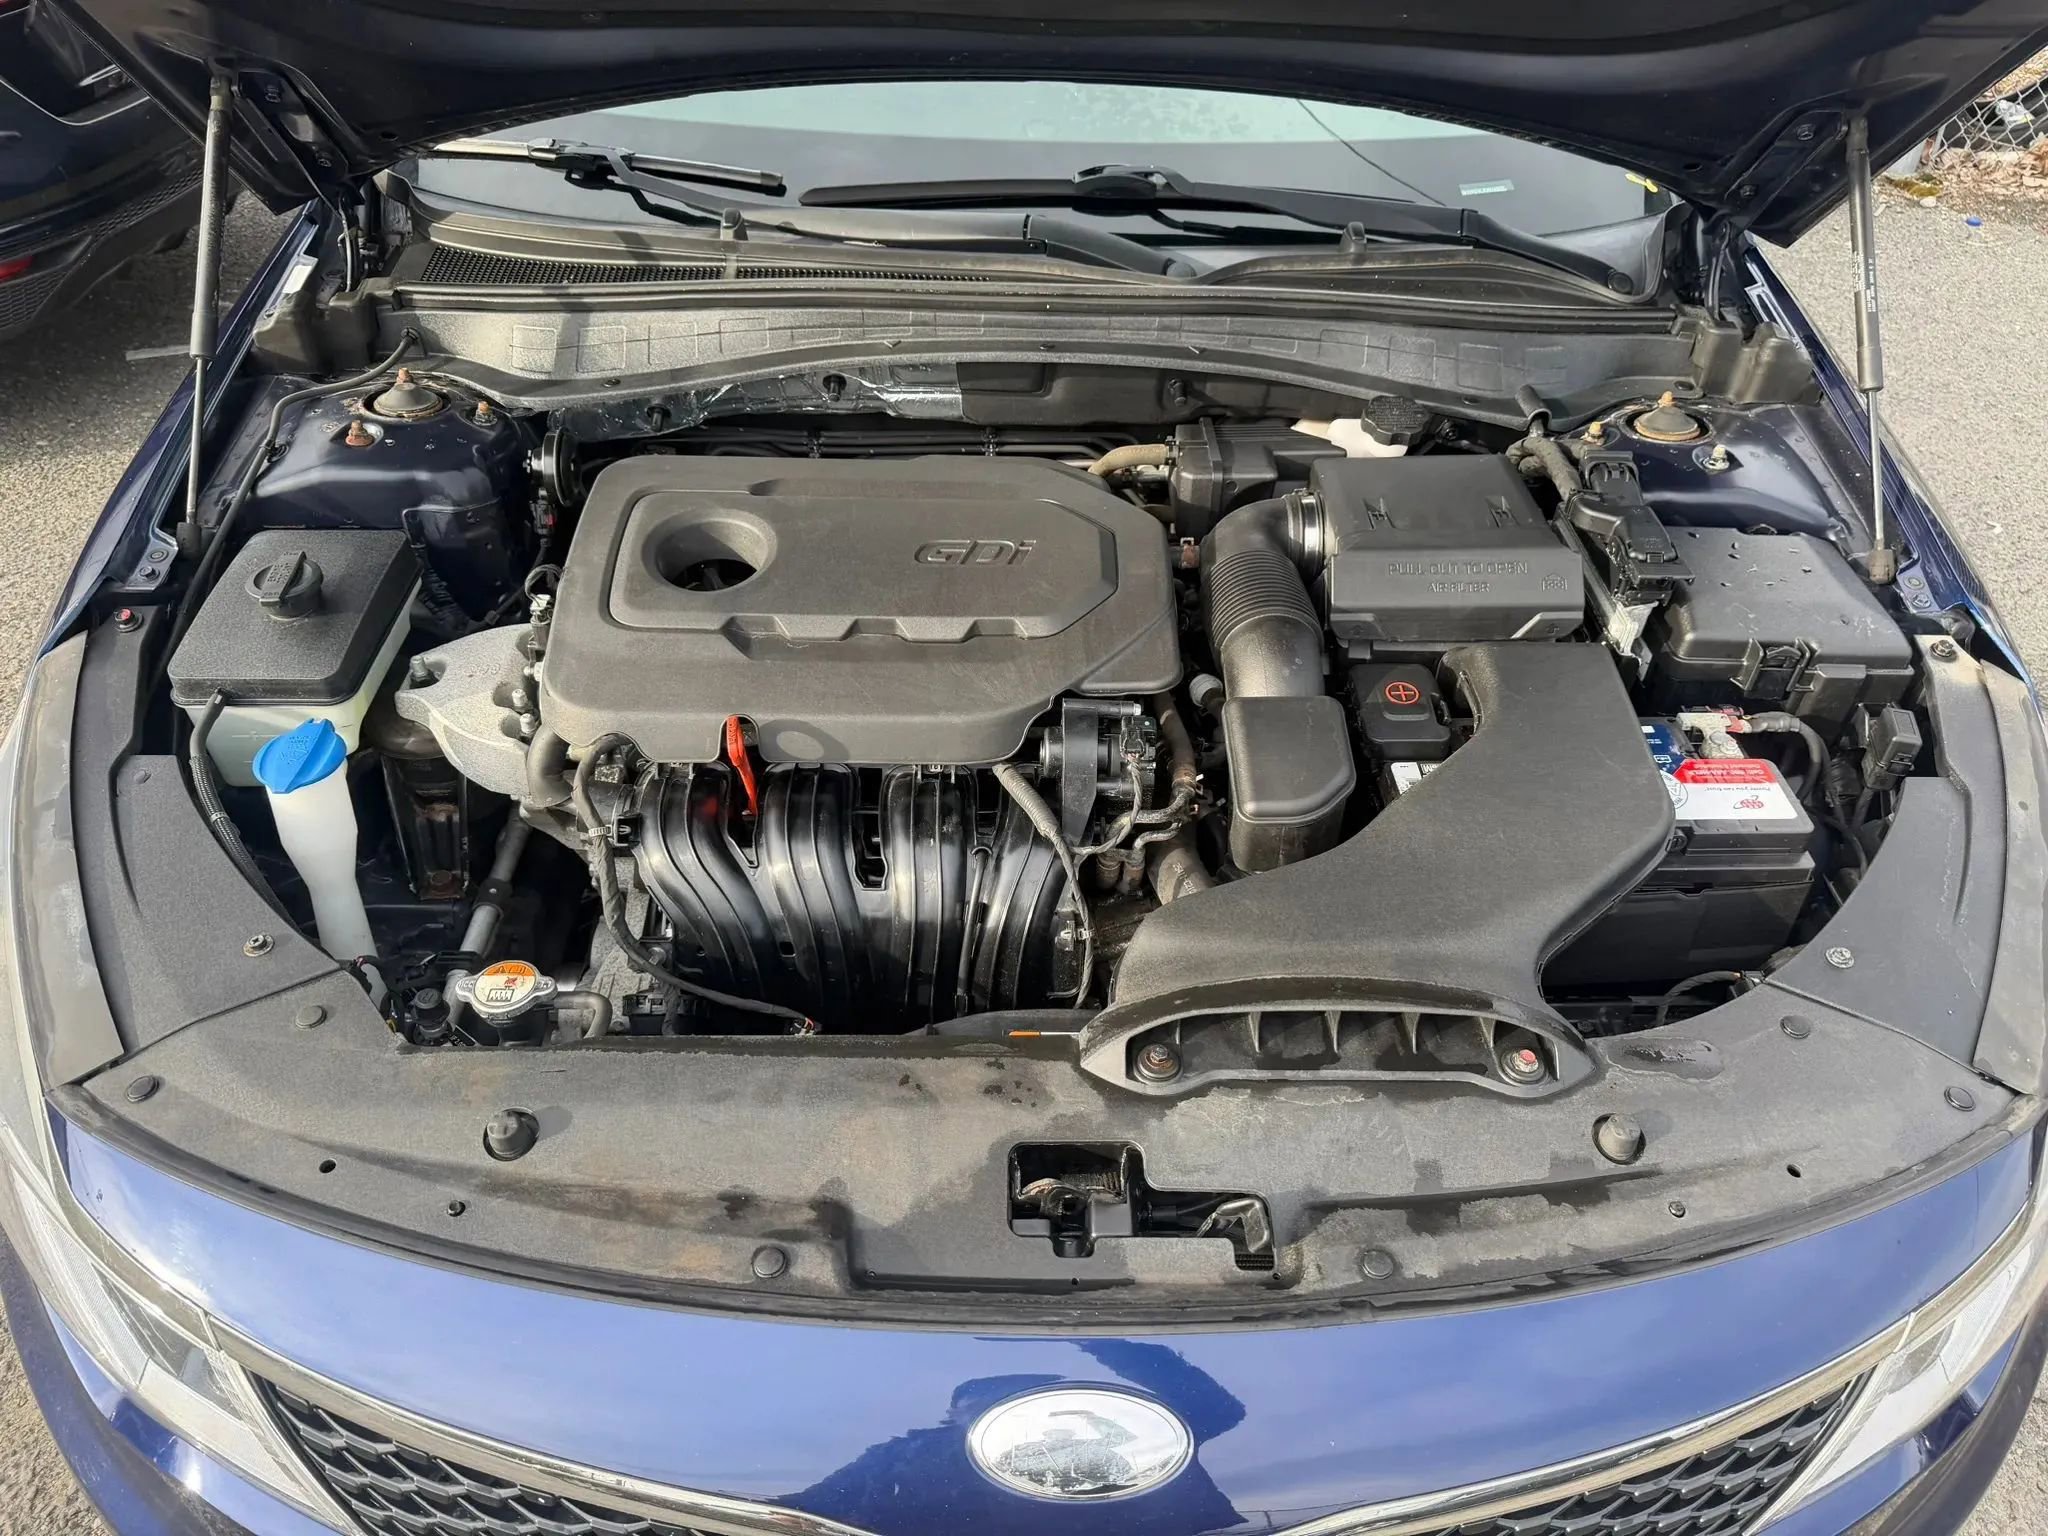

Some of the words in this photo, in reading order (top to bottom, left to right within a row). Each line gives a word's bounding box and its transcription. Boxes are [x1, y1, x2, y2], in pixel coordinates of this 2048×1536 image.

[914, 539, 1037, 565] GDi
[1388, 561, 1426, 576] PULL
[1429, 561, 1459, 575] OUT
[1464, 561, 1484, 575] TO
[1487, 560, 1529, 575] OPEN
[1427, 582, 1448, 593] AIR
[1450, 582, 1491, 593] FILTER
